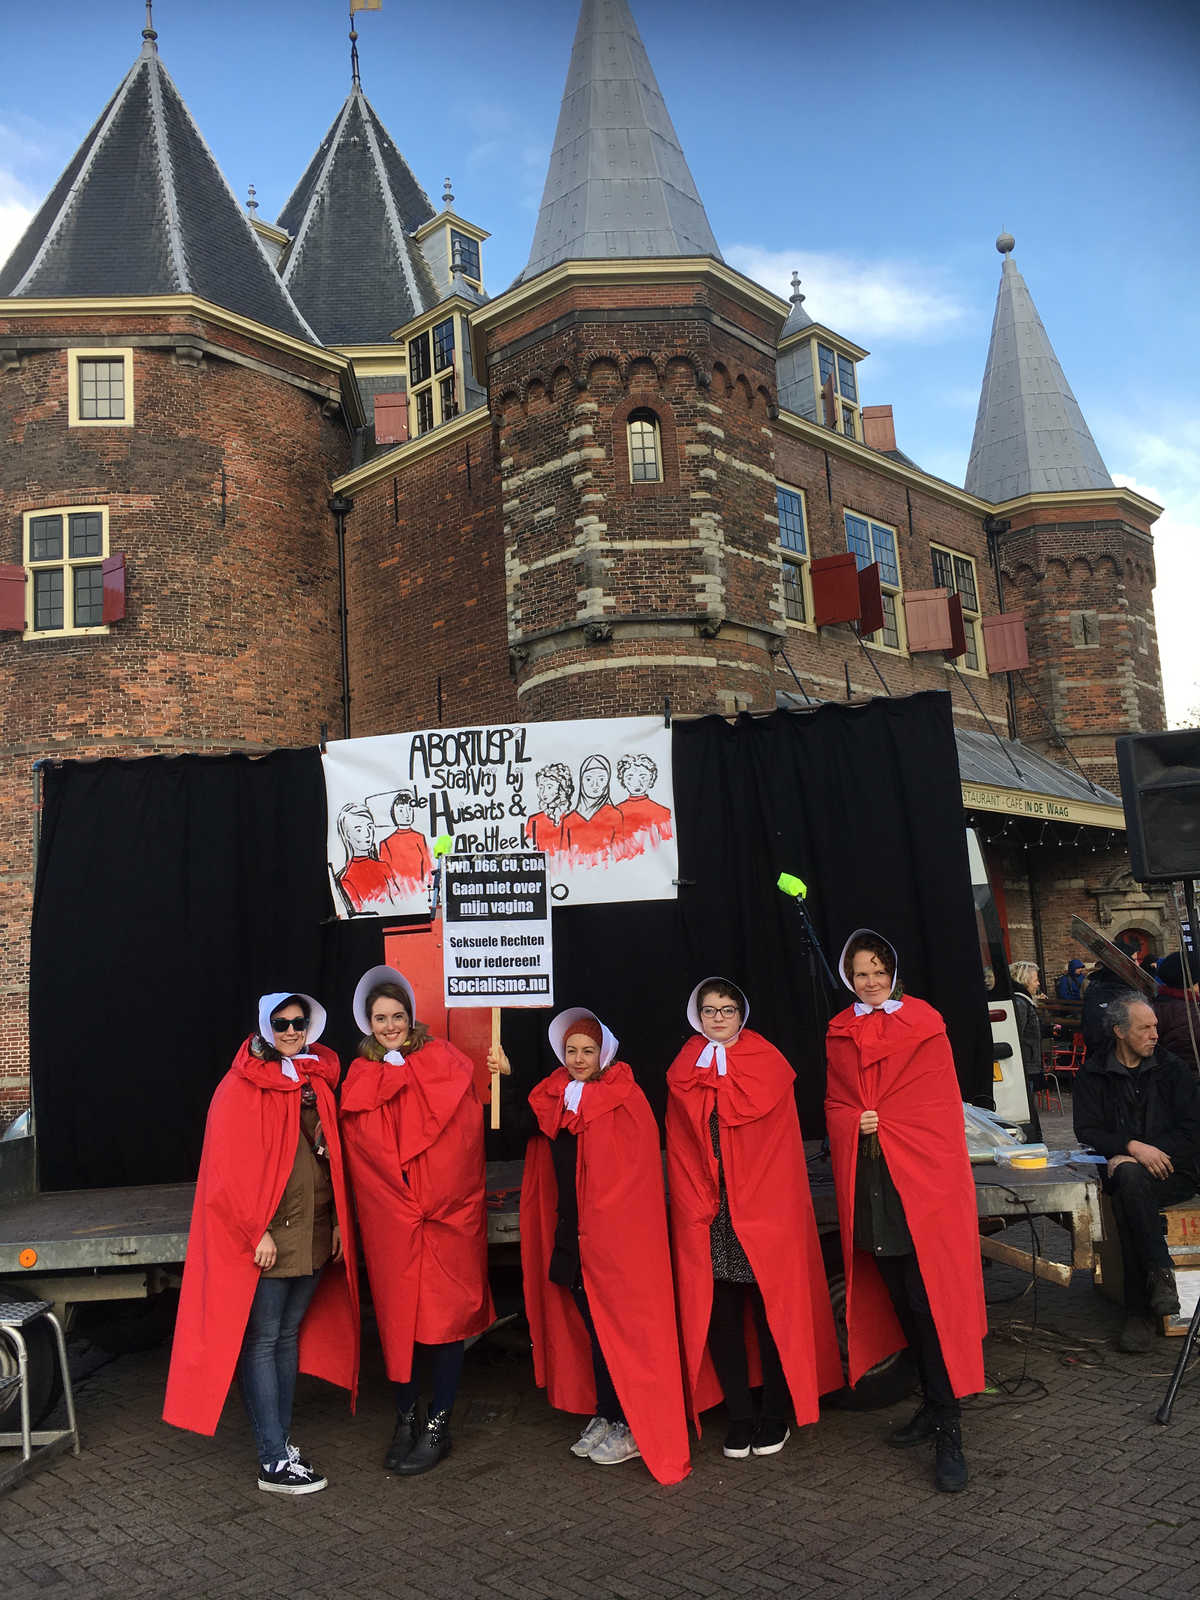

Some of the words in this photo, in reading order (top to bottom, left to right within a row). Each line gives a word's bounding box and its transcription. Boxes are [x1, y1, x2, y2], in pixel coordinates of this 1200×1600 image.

[409, 785, 428, 808] de
[429, 790, 505, 838] Huisarts
[508, 793, 527, 817] &
[475, 859, 500, 873] D66,
[502, 859, 520, 873] CU,
[452, 882, 484, 896] Gaan
[486, 881, 512, 895] niet
[513, 882, 542, 894] over
[460, 900, 489, 916] mijn
[491, 899, 534, 914] vagina
[450, 936, 498, 948] Seksuele
[500, 935, 545, 947] Rechten
[455, 956, 482, 969] Voor
[484, 954, 541, 968] iedereen!
[449, 978, 548, 993] Socialisme.nu
